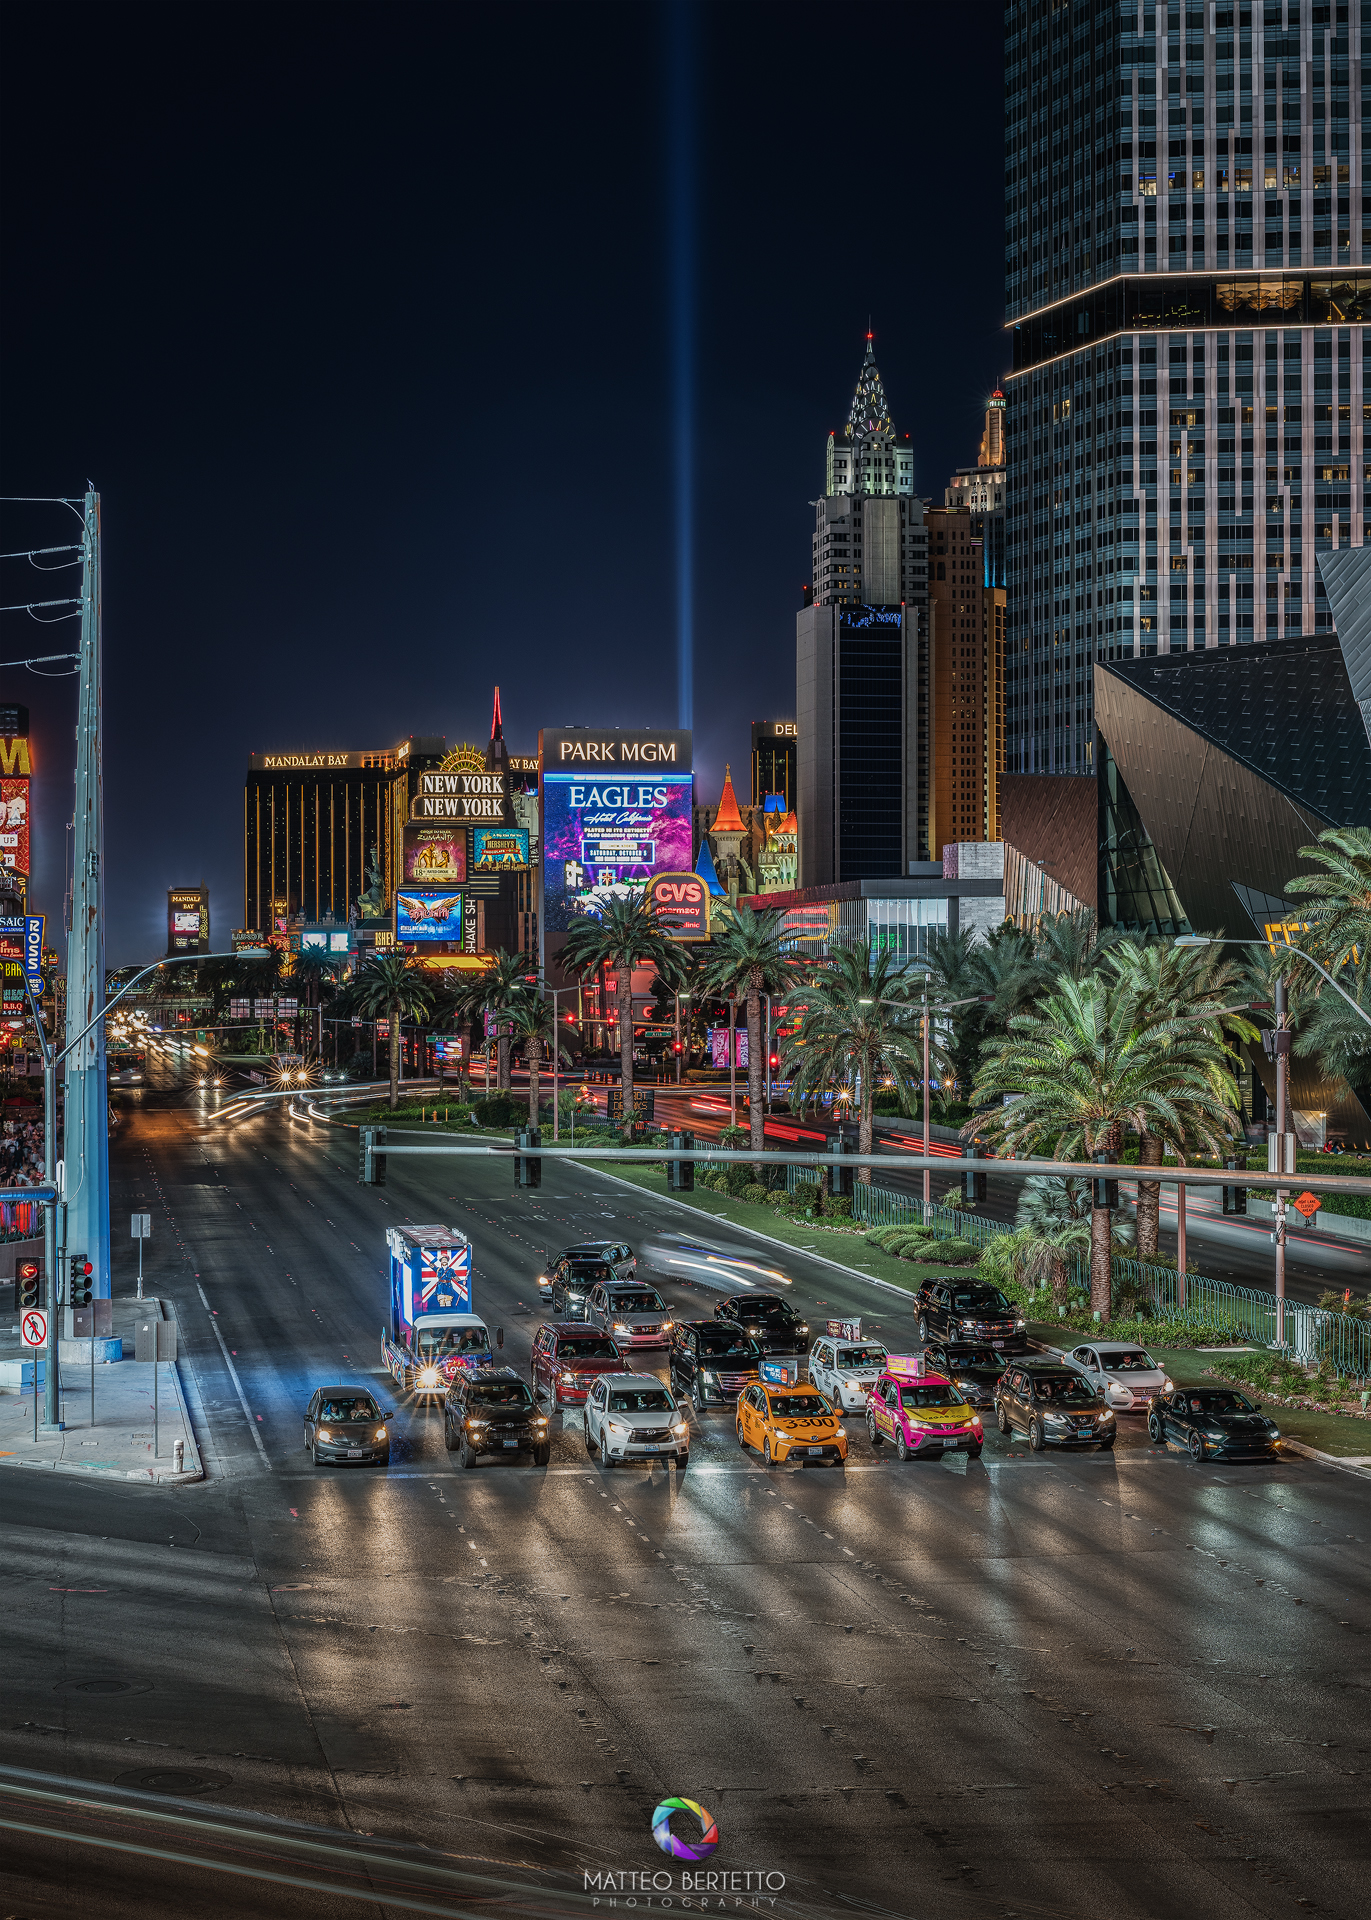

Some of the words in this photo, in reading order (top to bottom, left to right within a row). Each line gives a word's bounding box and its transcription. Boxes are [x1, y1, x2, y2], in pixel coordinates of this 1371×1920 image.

[561, 742, 616, 761] PARK
[621, 742, 676, 761] MGM
[264, 756, 325, 768] MANDALAY
[327, 754, 349, 766] BAY
[522, 759, 540, 770] BAY
[423, 775, 459, 793] NEW
[461, 775, 504, 793] YORK
[569, 786, 668, 808] EAGLES
[423, 798, 459, 816] NEW
[461, 798, 504, 816] YORK
[583, 812, 617, 825] Hotel
[487, 840, 515, 848] HERSHEY'S
[655, 882, 702, 903] CVS
[656, 906, 701, 916] pharmacy
[28, 919, 40, 970] ROSS
[465, 919, 476, 954] SHAKE
[783, 1418, 834, 1429] 3300
